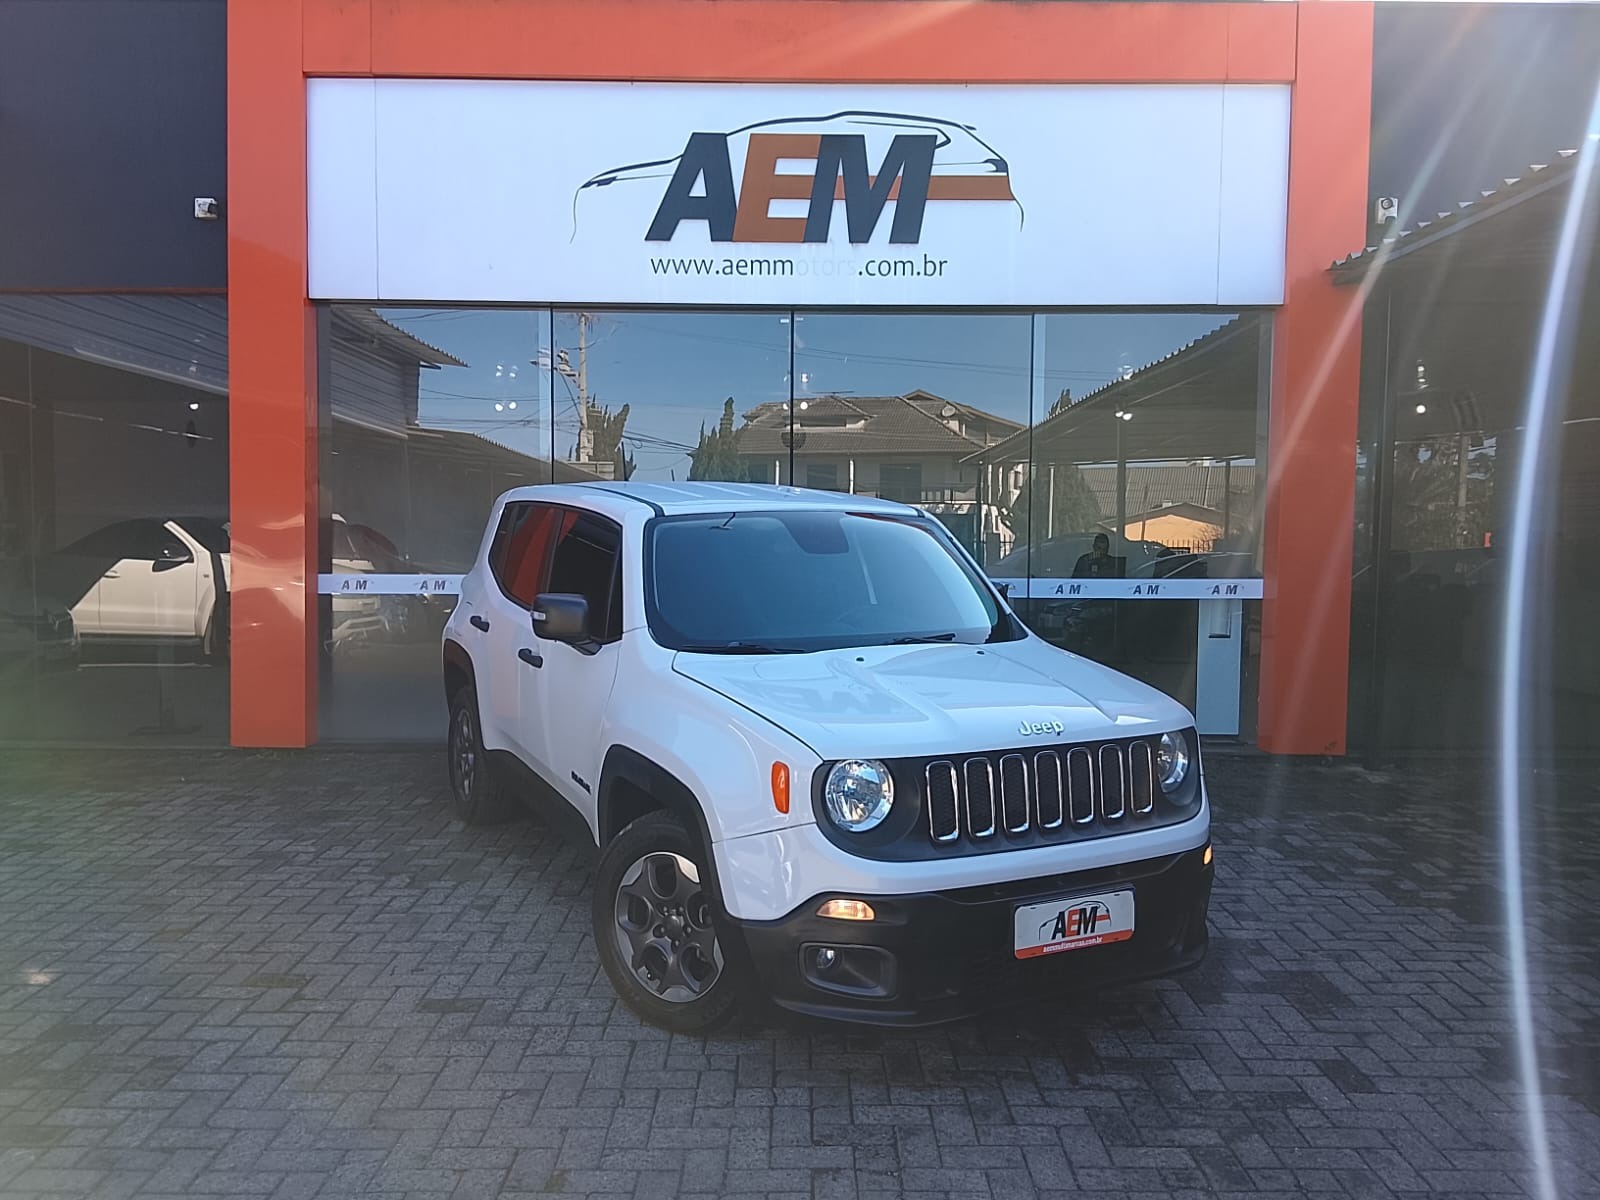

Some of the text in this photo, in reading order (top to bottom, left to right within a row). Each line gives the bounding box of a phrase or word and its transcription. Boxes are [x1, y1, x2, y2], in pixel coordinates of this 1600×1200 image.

[644, 132, 938, 244] AEM
[1018, 720, 1065, 736] Jeep
[1051, 905, 1099, 940] AEM
